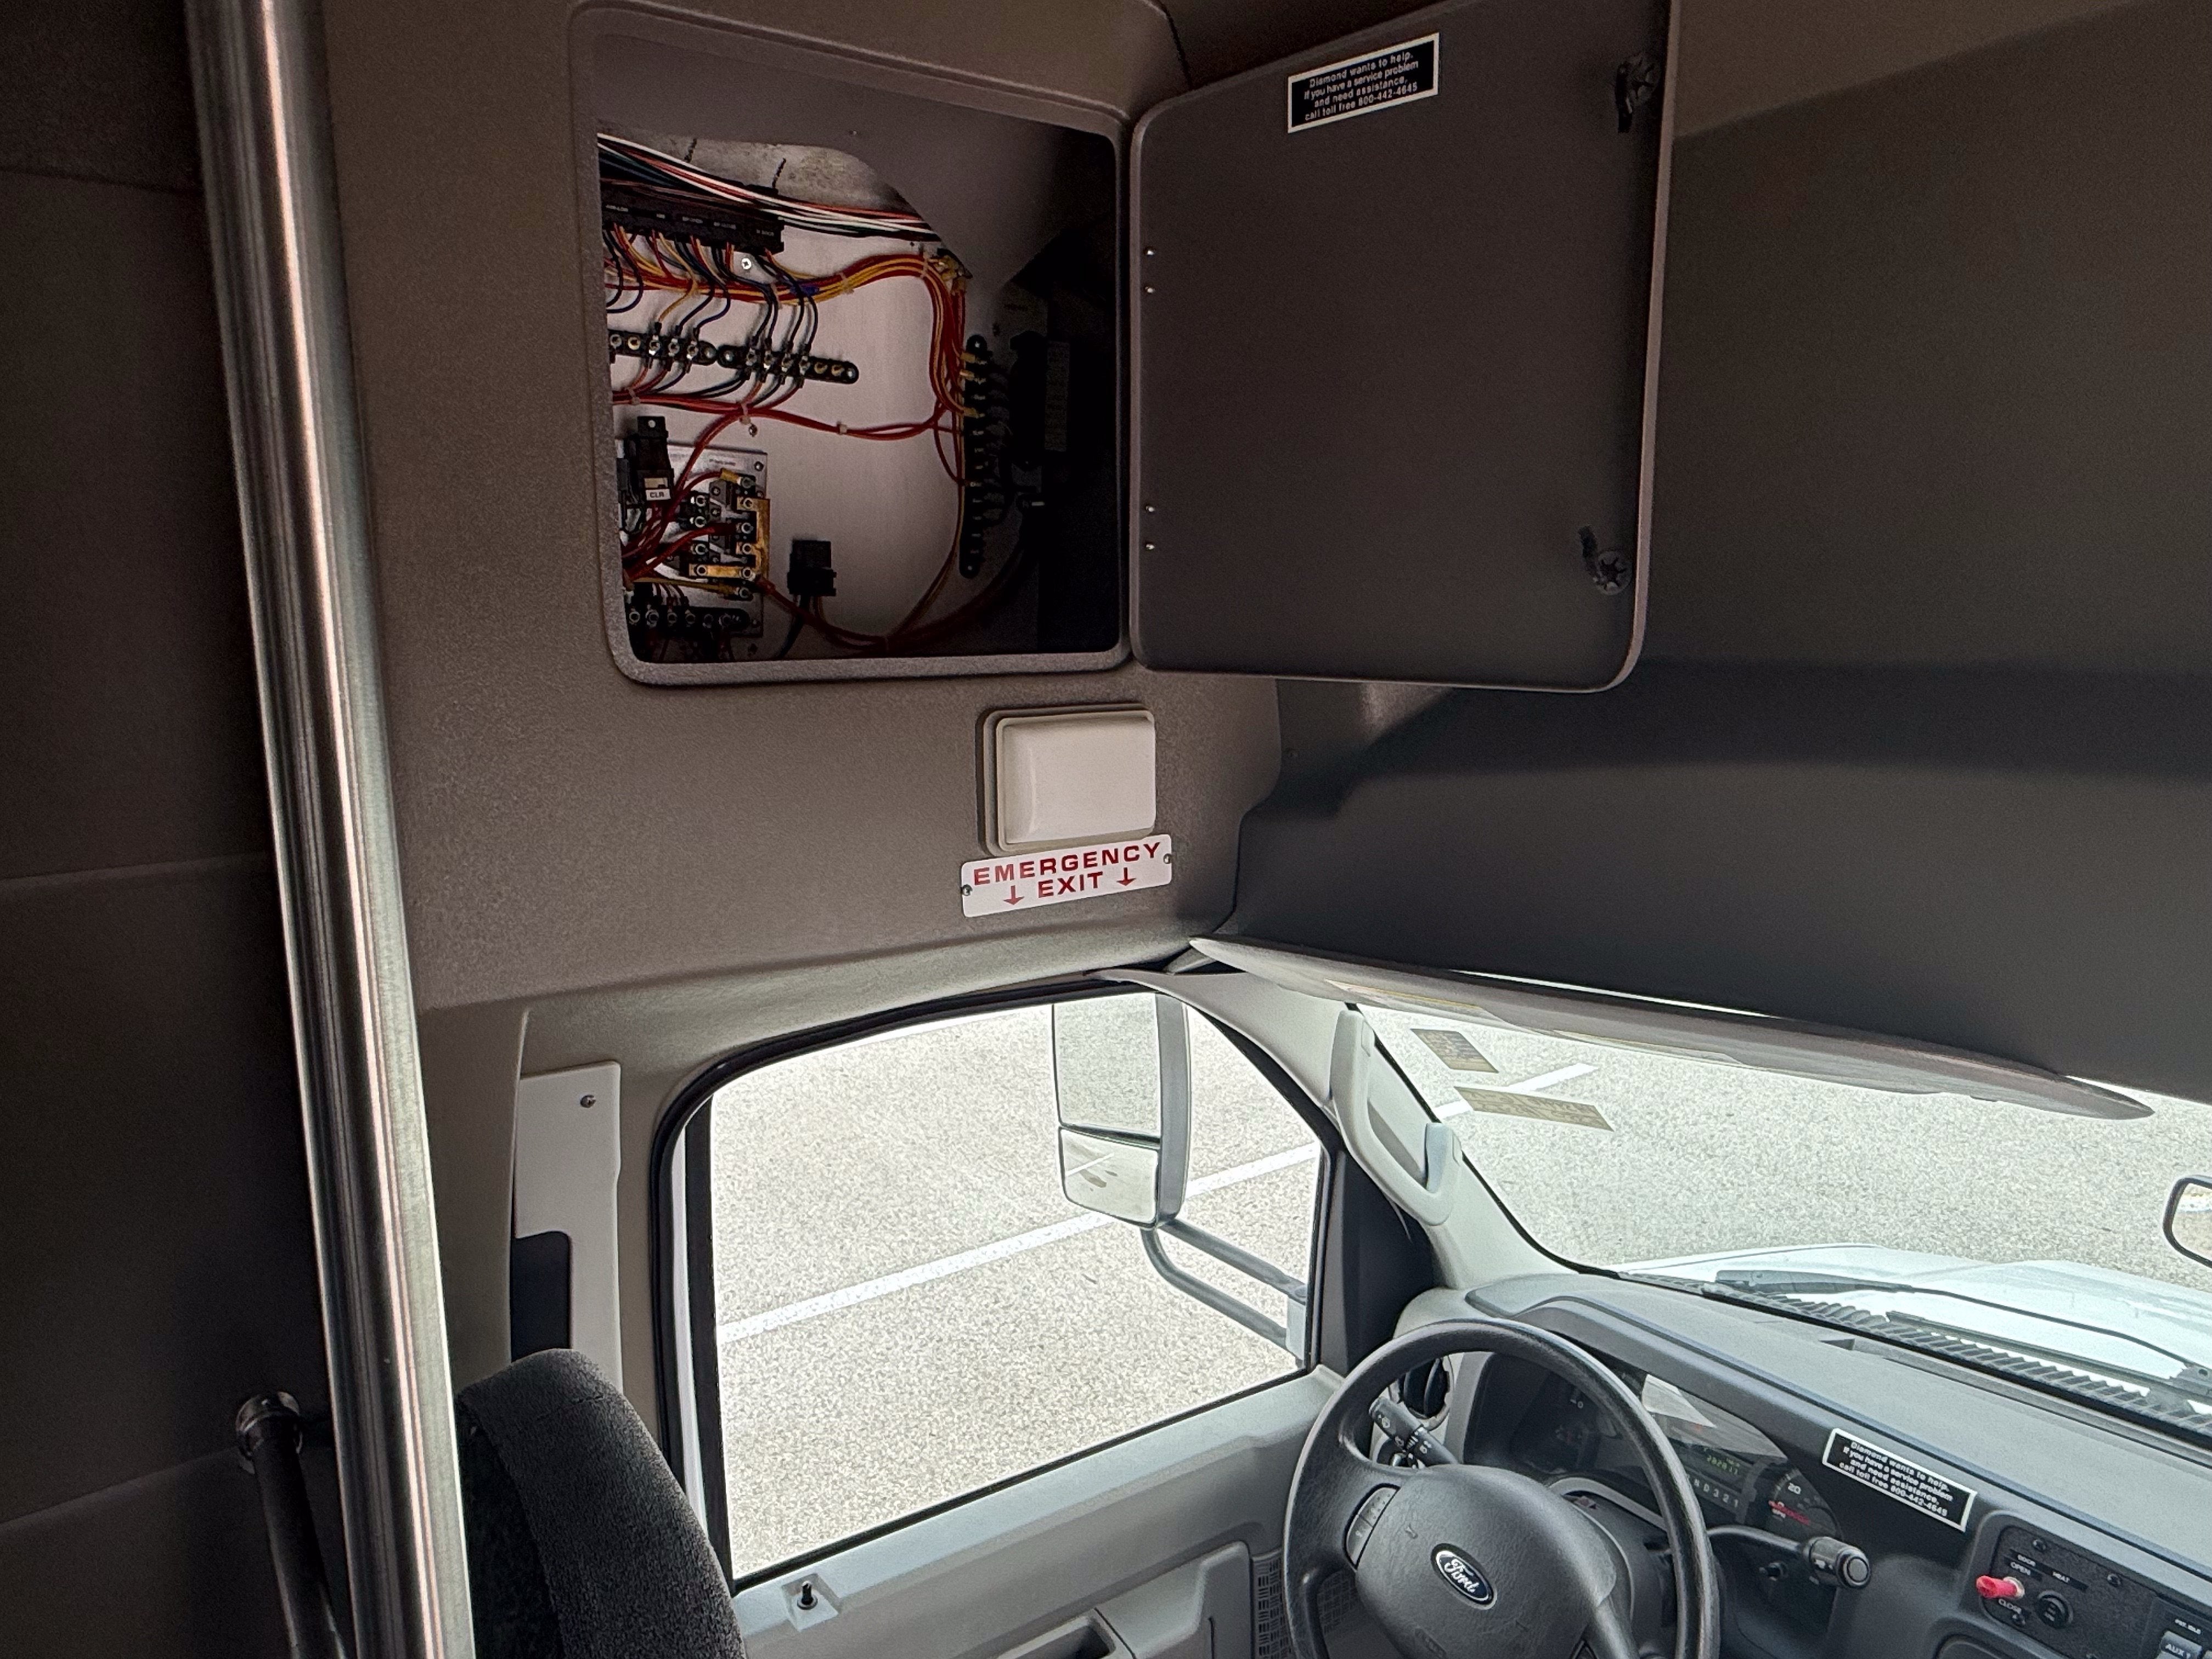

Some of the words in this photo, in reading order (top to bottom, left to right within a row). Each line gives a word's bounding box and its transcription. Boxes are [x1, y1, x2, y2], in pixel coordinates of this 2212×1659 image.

[1304, 89, 1310, 100] If
[1311, 88, 1325, 100] you
[1327, 82, 1345, 93] have
[1347, 80, 1352, 88] a
[1354, 70, 1383, 86] service
[1385, 61, 1419, 80] problem
[1310, 69, 1347, 88] Diamond
[1350, 62, 1376, 76] wants
[1379, 58, 1388, 68] to
[1390, 51, 1414, 64] help.
[1305, 108, 1321, 121] call
[1322, 104, 1336, 116] toll
[1339, 101, 1356, 111] free
[1314, 95, 1330, 108] and
[1333, 88, 1354, 103] need
[973, 842, 1161, 885] EMERGENCY
[1038, 871, 1104, 899] EXIT
[1850, 1441, 1888, 1464] Diamond
[1889, 1460, 1915, 1476] wants
[1917, 1471, 1926, 1480] to
[1850, 1459, 1867, 1470] and
[1867, 1467, 1889, 1481] need
[1787, 1482, 1802, 1494] 20
[1839, 1462, 1855, 1473] call
[1856, 1469, 1871, 1480] toll
[1871, 1476, 1888, 1489] free
[1849, 1450, 1864, 1461] you
[1865, 1456, 1883, 1470] have
[1890, 1469, 1919, 1486] service
[1920, 1482, 1953, 1501] problem
[1703, 1483, 1709, 1492] D
[1713, 1488, 1719, 1498] 3
[1723, 1493, 1729, 1503] 2
[1734, 1499, 1739, 1508] 1
[1444, 1559, 1479, 1593] Ford
[2165, 1644, 2185, 1657] AUX
